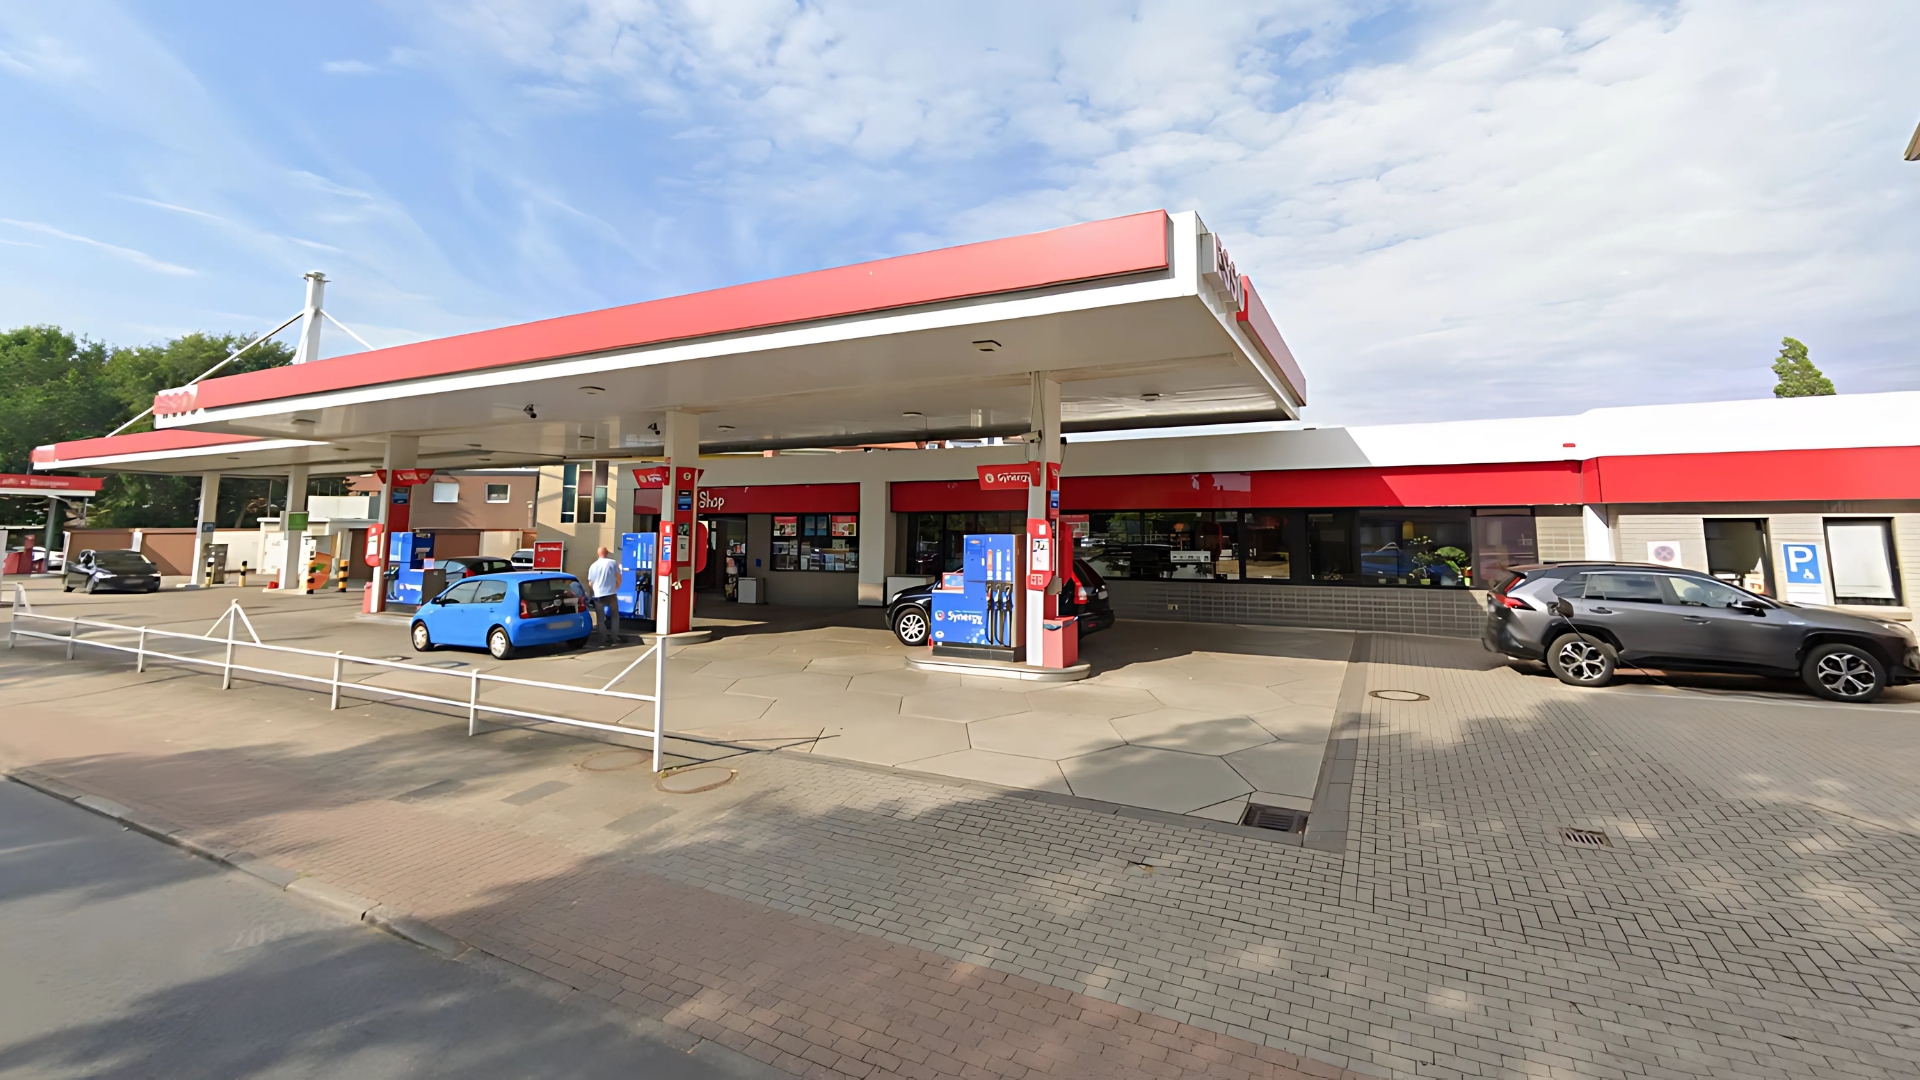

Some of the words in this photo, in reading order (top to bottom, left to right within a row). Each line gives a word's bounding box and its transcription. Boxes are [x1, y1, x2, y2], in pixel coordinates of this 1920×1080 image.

[698, 490, 725, 511] Shop
[1787, 546, 1814, 573] P
[947, 610, 983, 626] Synergy
